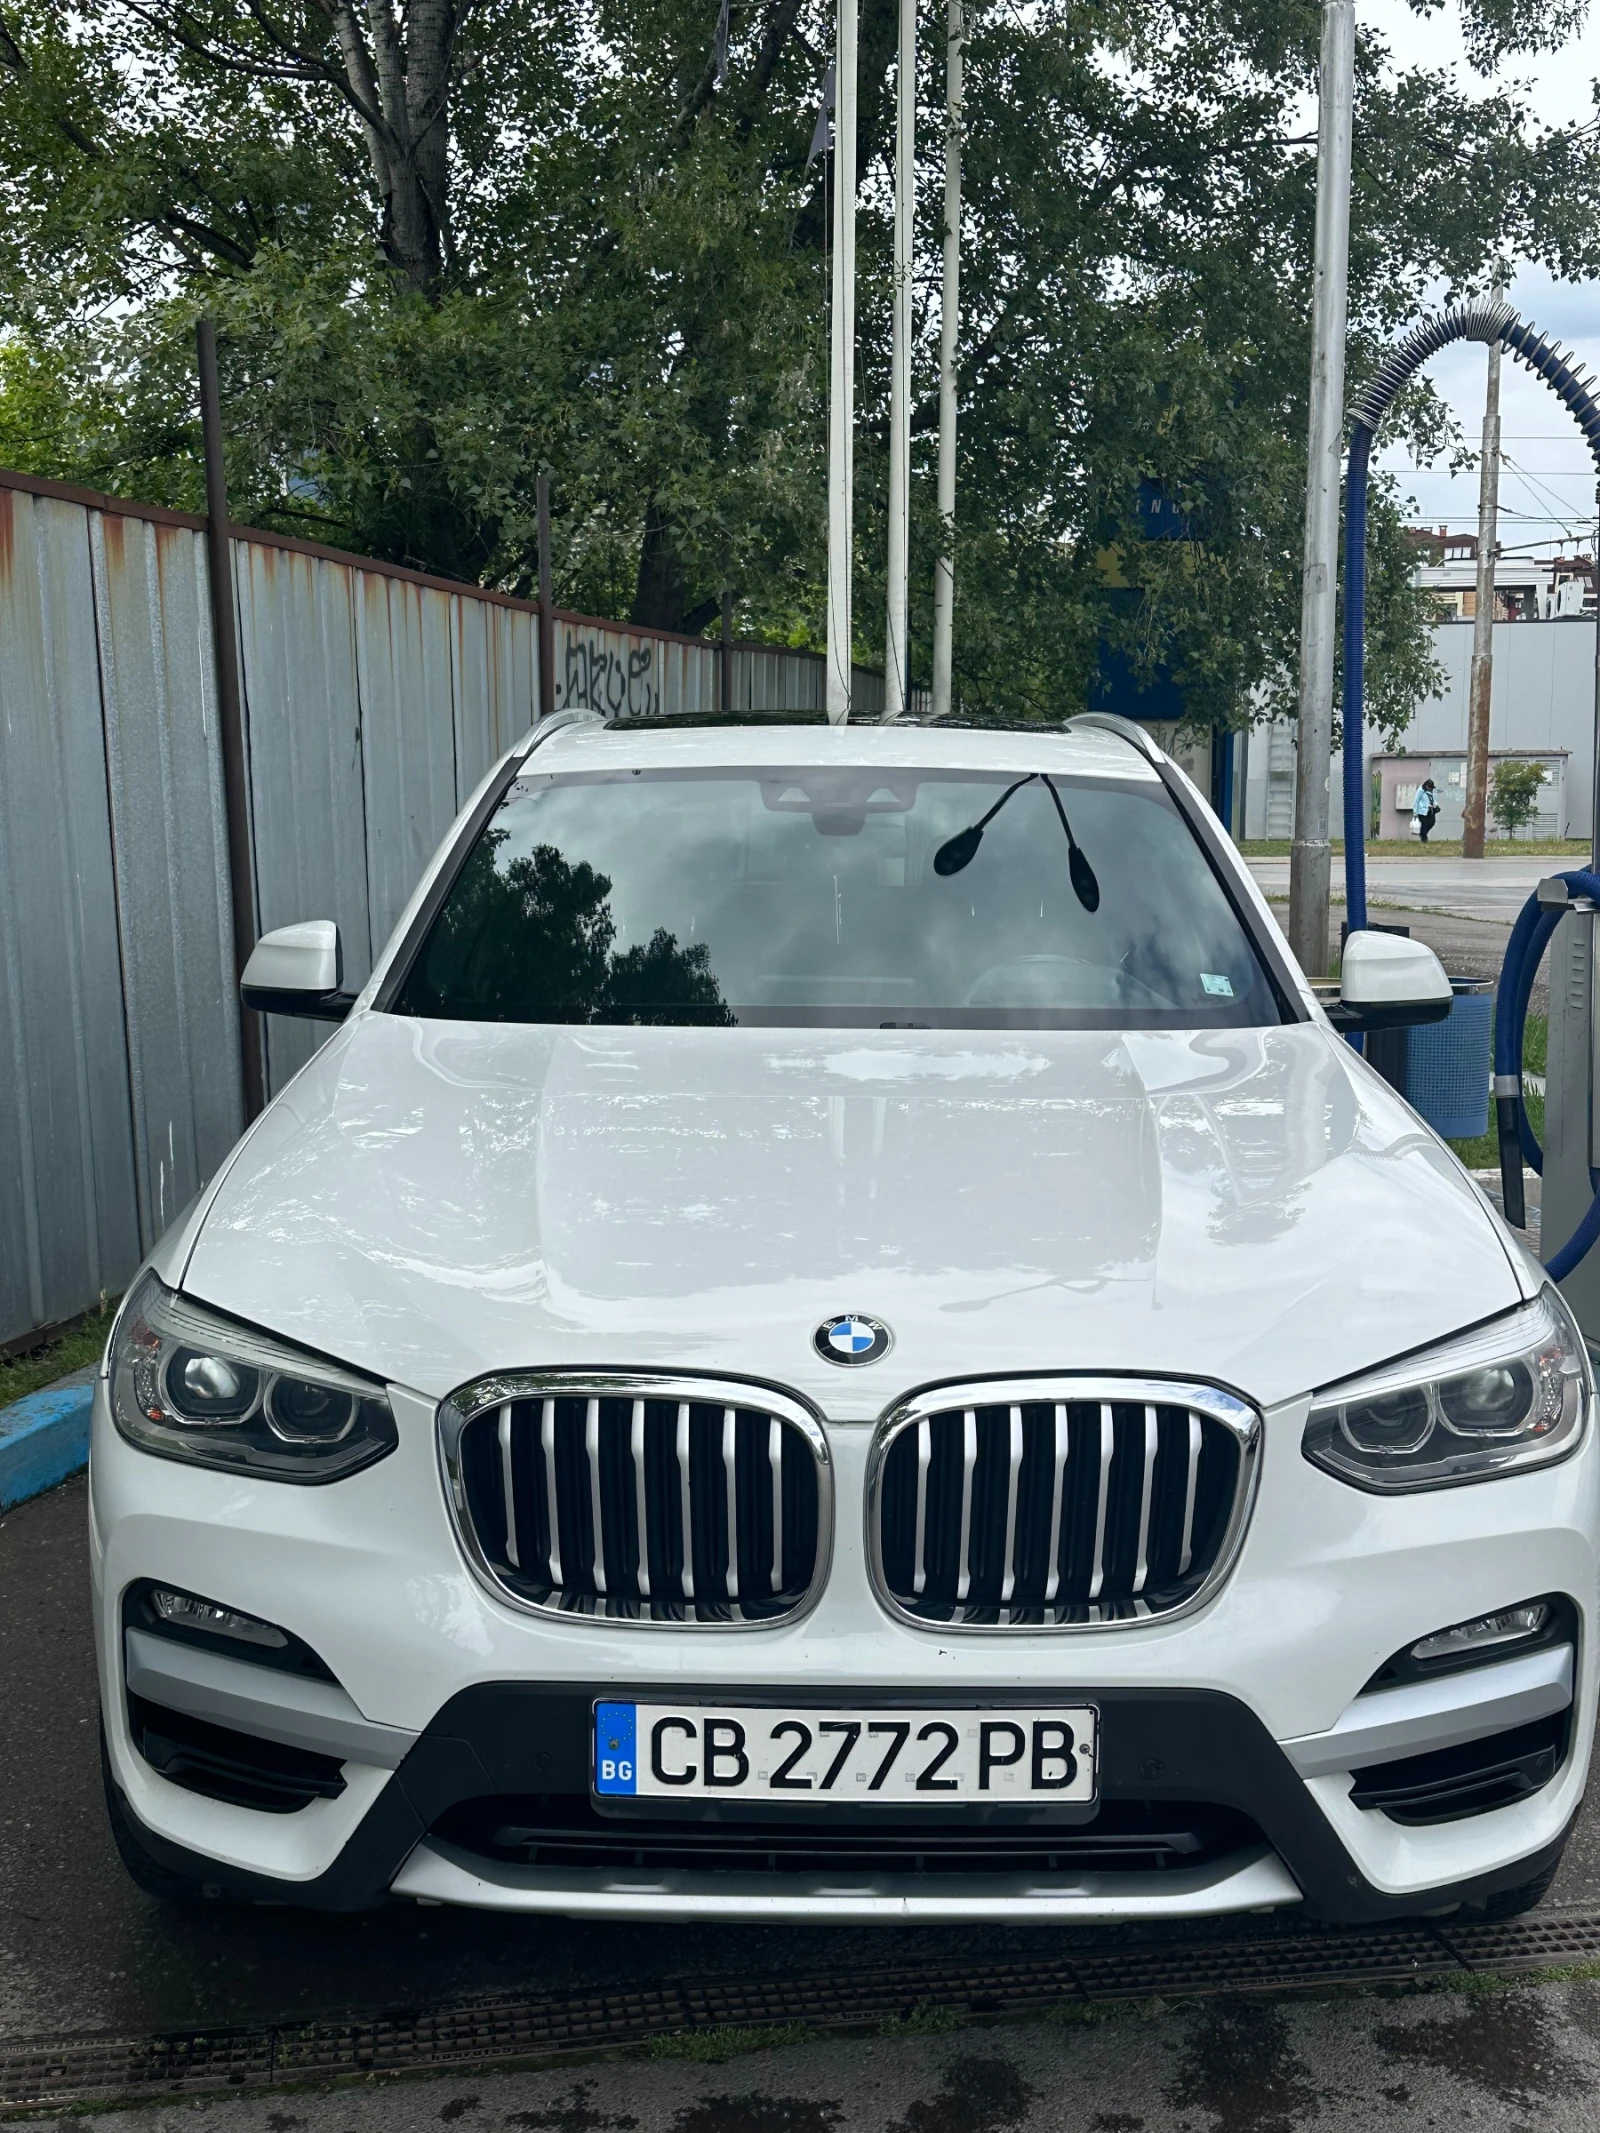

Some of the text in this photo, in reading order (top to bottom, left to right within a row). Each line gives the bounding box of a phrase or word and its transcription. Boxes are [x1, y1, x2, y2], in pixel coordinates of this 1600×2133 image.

[822, 1315, 883, 1330] BMW
[651, 1716, 1078, 1790] CB 2772 PB
[601, 1759, 633, 1781] BG
